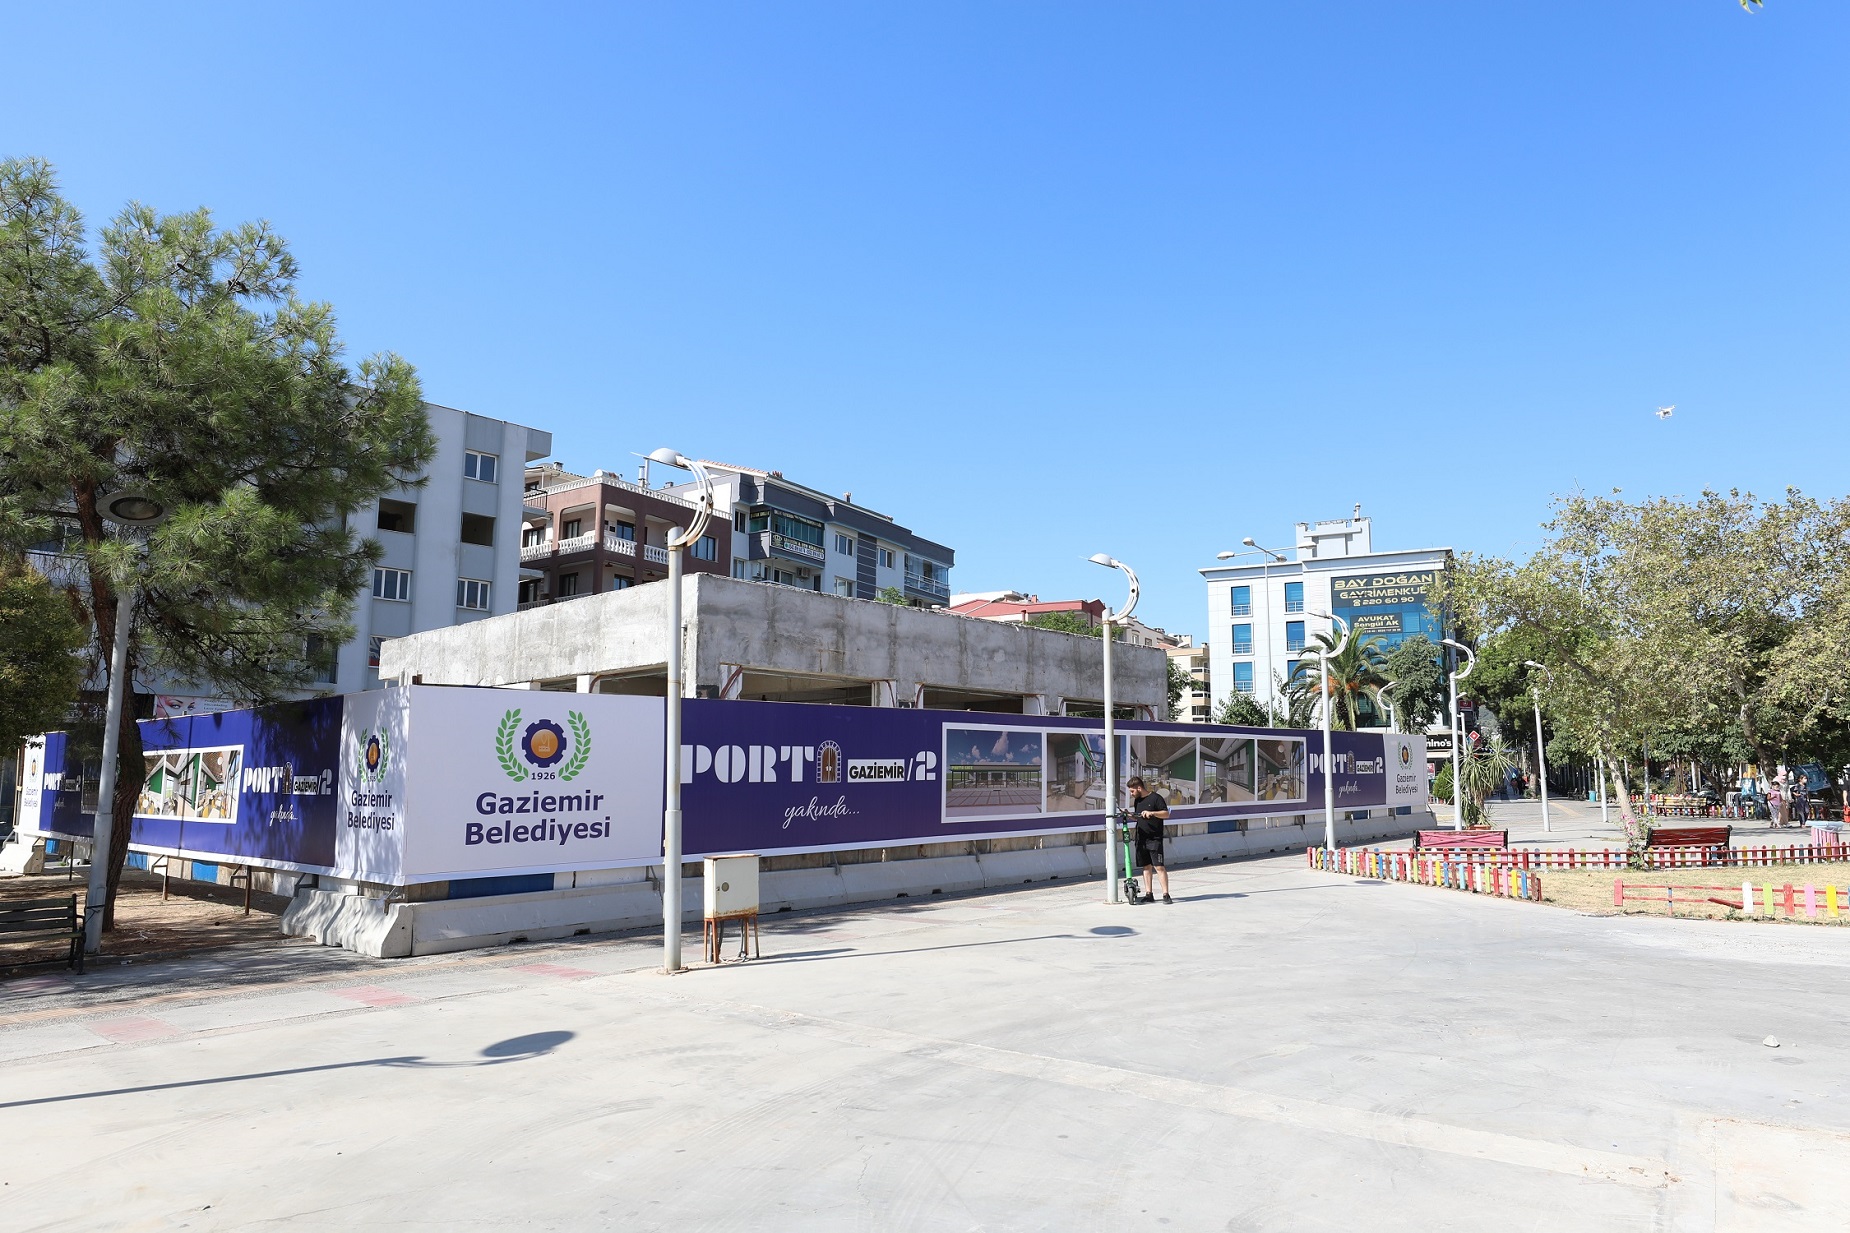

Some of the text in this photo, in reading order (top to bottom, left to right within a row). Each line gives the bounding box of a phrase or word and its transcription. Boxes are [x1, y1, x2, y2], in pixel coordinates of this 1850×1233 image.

[1335, 574, 1432, 589] BAY DOĞAN
[1357, 614, 1395, 622] AVUKAT
[531, 772, 556, 780] 1926
[849, 761, 904, 779] GAZİEMİR
[1396, 773, 1416, 783] Gaziemir
[1395, 784, 1419, 796] Belediyesi
[351, 790, 392, 807] Gaziemir
[476, 789, 604, 815] Gaziemir
[347, 812, 395, 833] Belediyesi
[465, 816, 611, 846] Belediyesi
